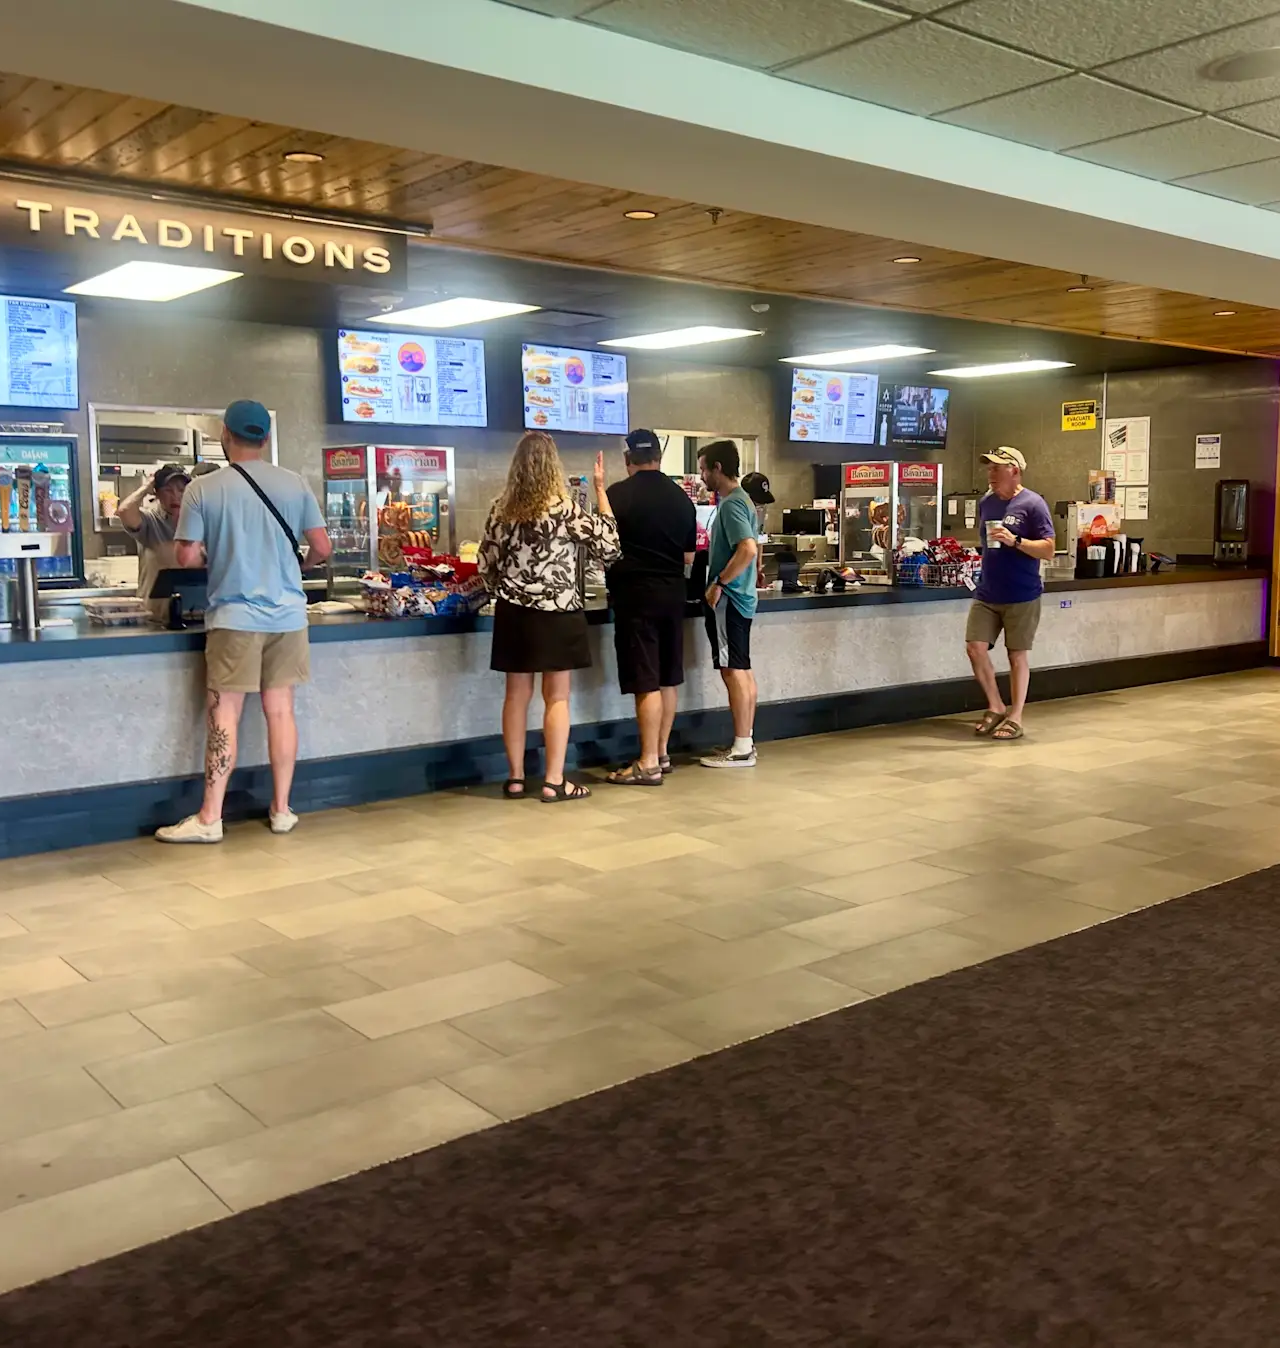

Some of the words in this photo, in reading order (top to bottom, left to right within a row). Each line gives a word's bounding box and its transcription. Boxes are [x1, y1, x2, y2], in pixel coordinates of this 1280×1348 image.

[16, 199, 392, 275] TRADITIONS
[1066, 415, 1091, 423] EVACUATE
[851, 468, 884, 479] Bavarian
